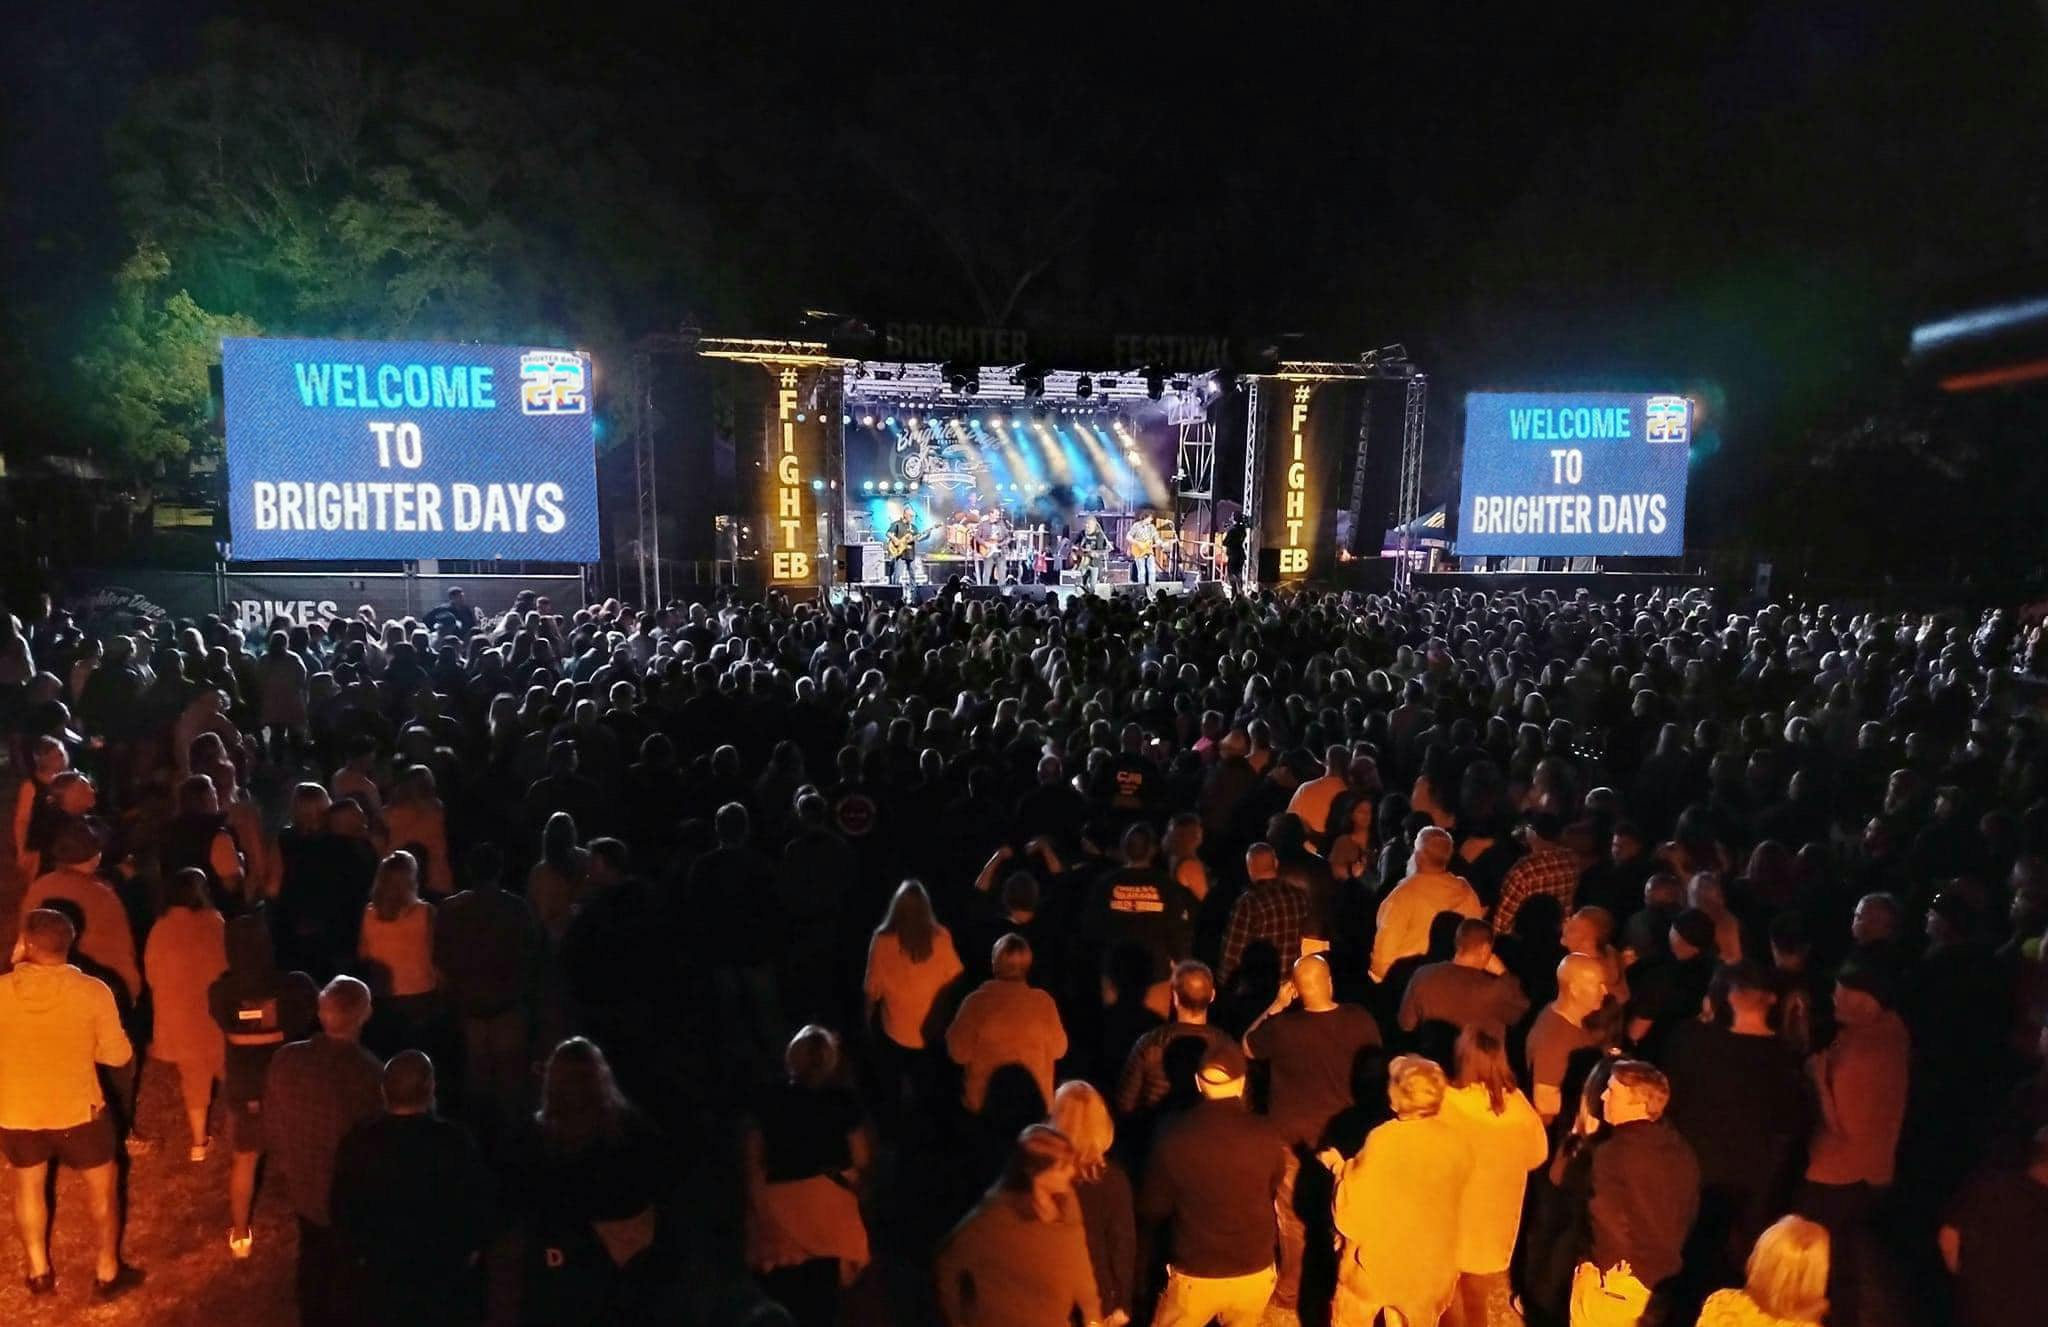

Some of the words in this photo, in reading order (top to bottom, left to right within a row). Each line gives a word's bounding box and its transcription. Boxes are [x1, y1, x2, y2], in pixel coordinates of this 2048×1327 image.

[884, 321, 1028, 361] BRIGHTER
[294, 363, 496, 408] WELCOME
[521, 363, 585, 415] 22
[1509, 407, 1631, 441] WELCOME
[369, 421, 423, 469] TO
[1551, 448, 1583, 485] TO
[253, 480, 444, 532] BRIGHTER
[452, 481, 566, 534] DAYS
[1472, 494, 1592, 534] BRIGHTER
[1598, 493, 1667, 534] DAYS
[772, 552, 809, 579] EB
[1279, 548, 1309, 574] EB
[240, 600, 338, 630] BIKES
